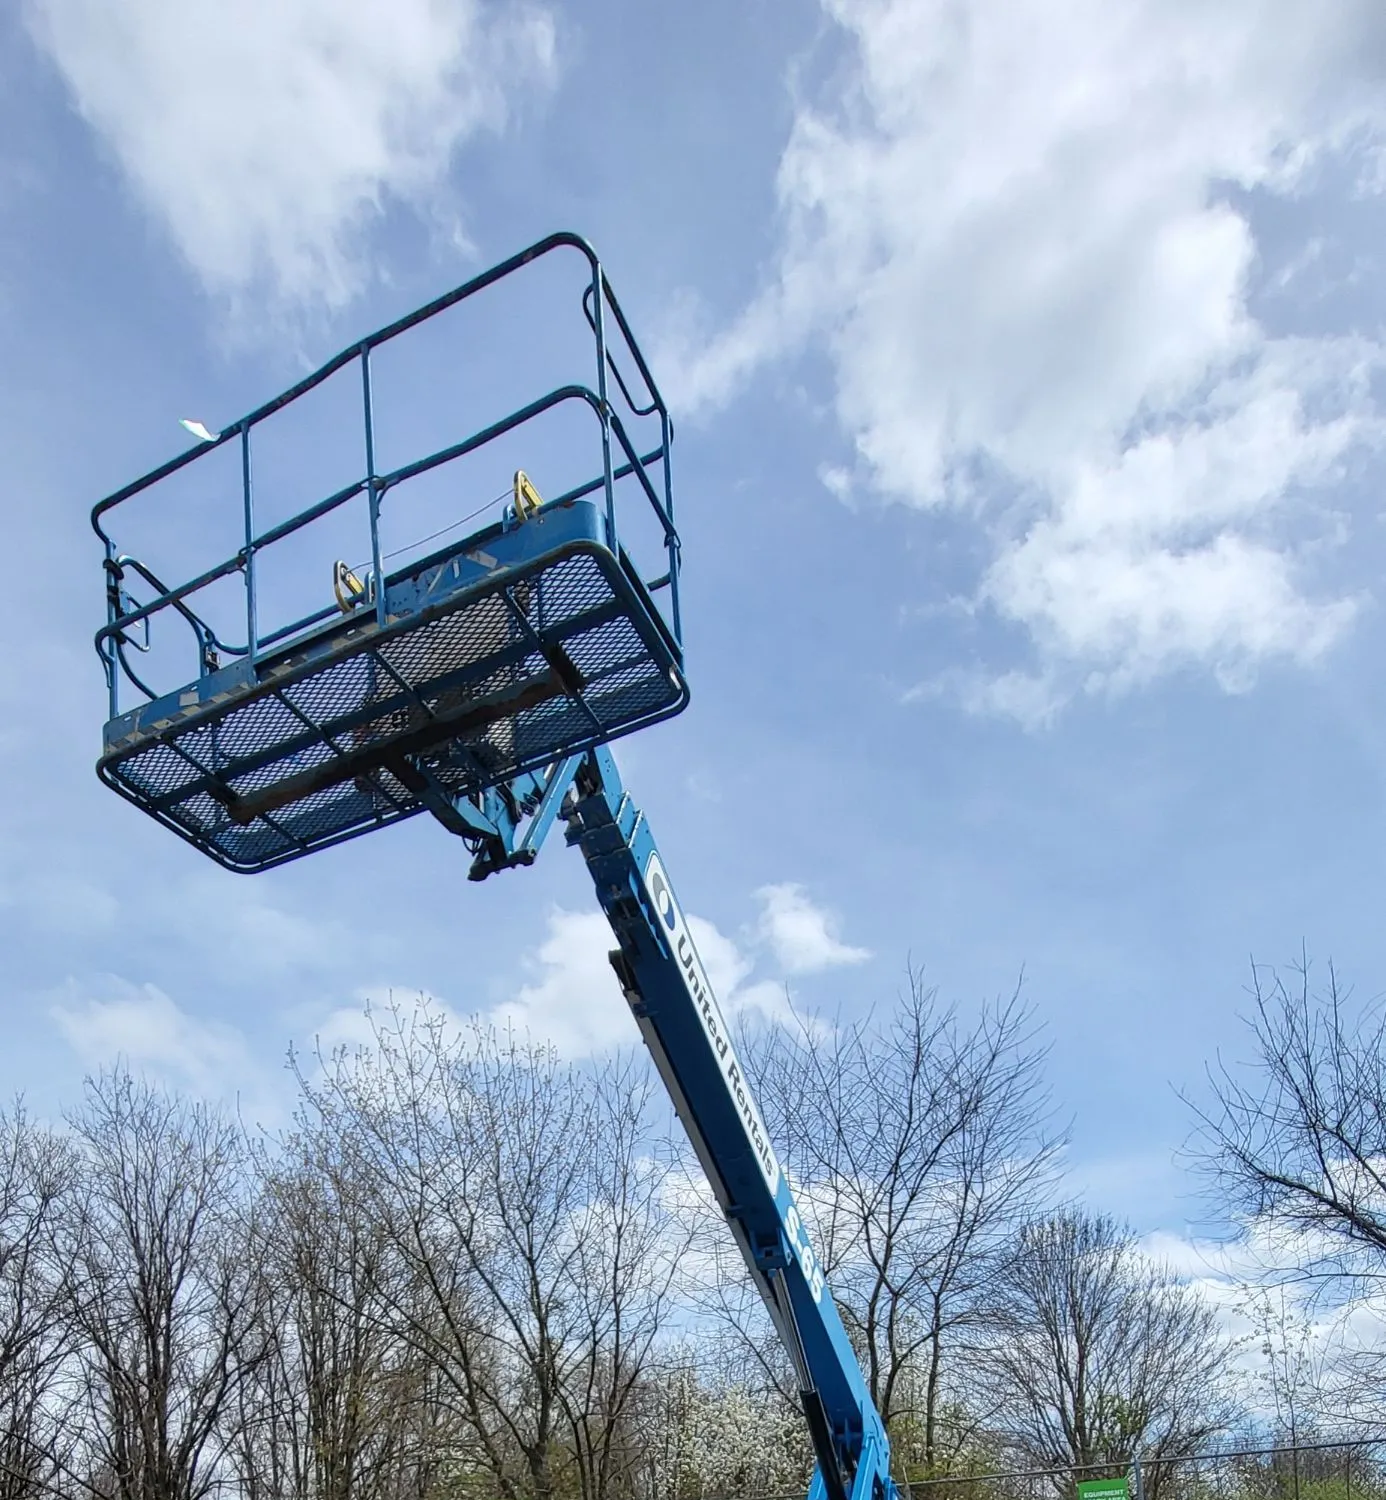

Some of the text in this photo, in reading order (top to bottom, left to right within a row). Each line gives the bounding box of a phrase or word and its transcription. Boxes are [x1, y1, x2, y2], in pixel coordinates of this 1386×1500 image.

[677, 933, 773, 1178] United Rentals
[784, 1204, 825, 1304] S-65
[1083, 1489, 1124, 1499] EQUIPMENT
